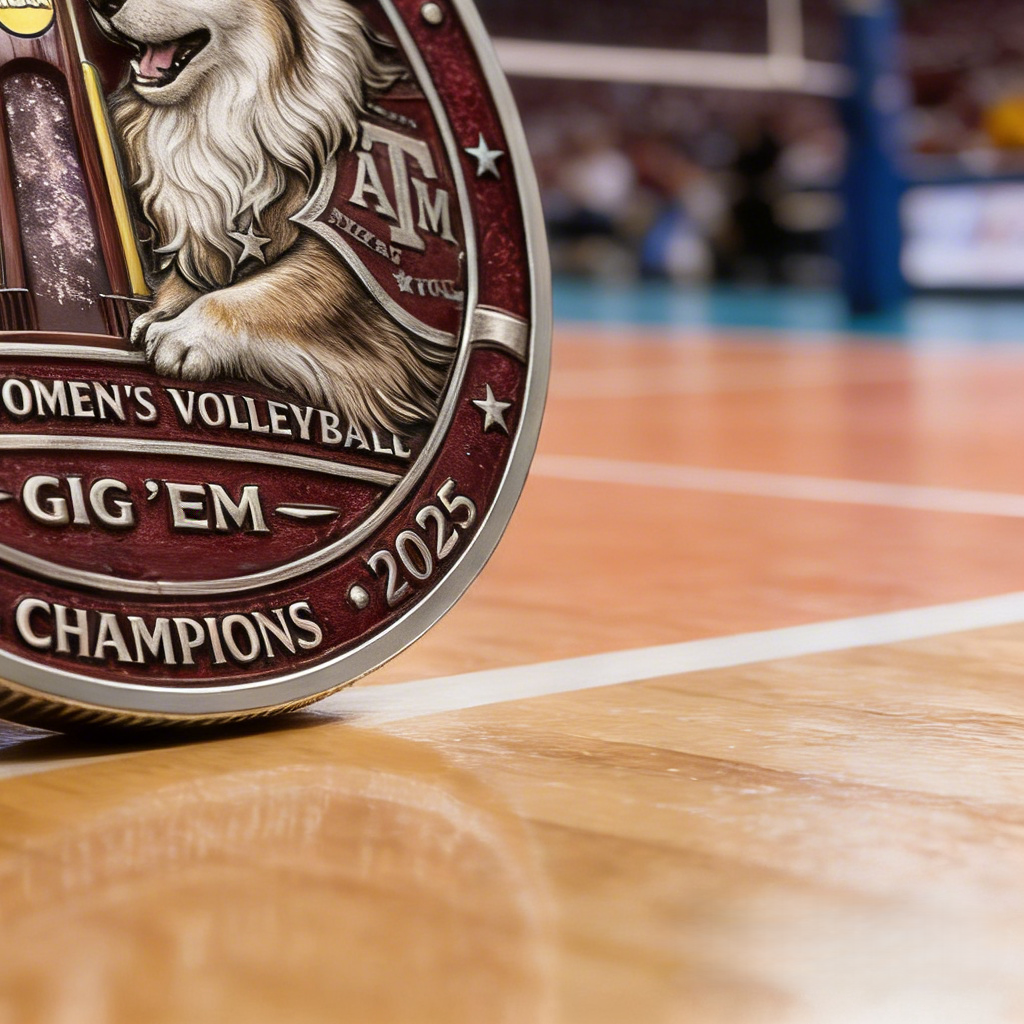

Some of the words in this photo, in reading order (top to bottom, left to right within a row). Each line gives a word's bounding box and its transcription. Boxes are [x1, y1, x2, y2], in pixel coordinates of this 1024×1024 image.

[22, 476, 135, 528] GIG
[147, 479, 271, 533] 'EM
[16, 598, 322, 666] CHAMPIONS
[367, 479, 478, 608] 2025
